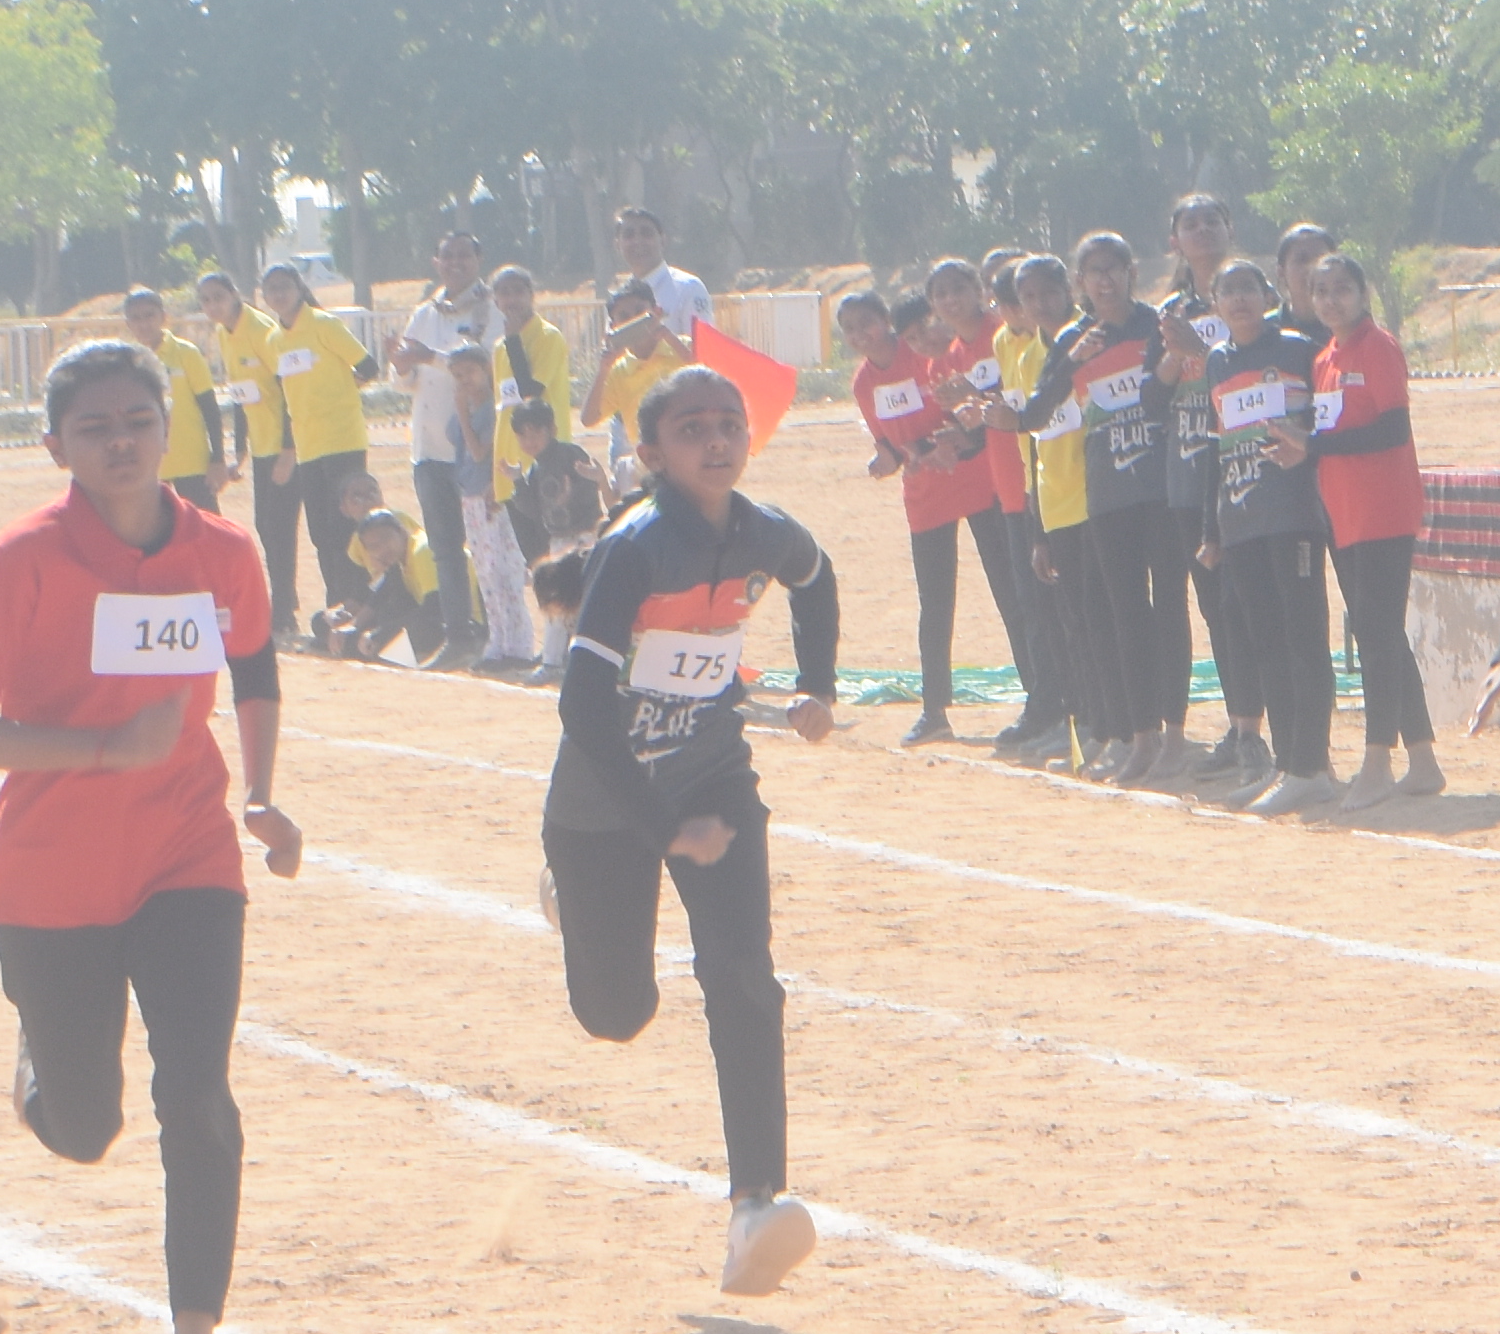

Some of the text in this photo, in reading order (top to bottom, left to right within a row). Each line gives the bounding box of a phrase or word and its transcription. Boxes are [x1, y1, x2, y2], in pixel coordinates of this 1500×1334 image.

[885, 391, 908, 410] 164
[1108, 376, 1140, 398] 141
[1237, 392, 1265, 413] 144
[1110, 424, 1155, 453] BLUE
[1178, 410, 1206, 441] BLU
[134, 618, 200, 651] 140
[668, 651, 727, 681] 175
